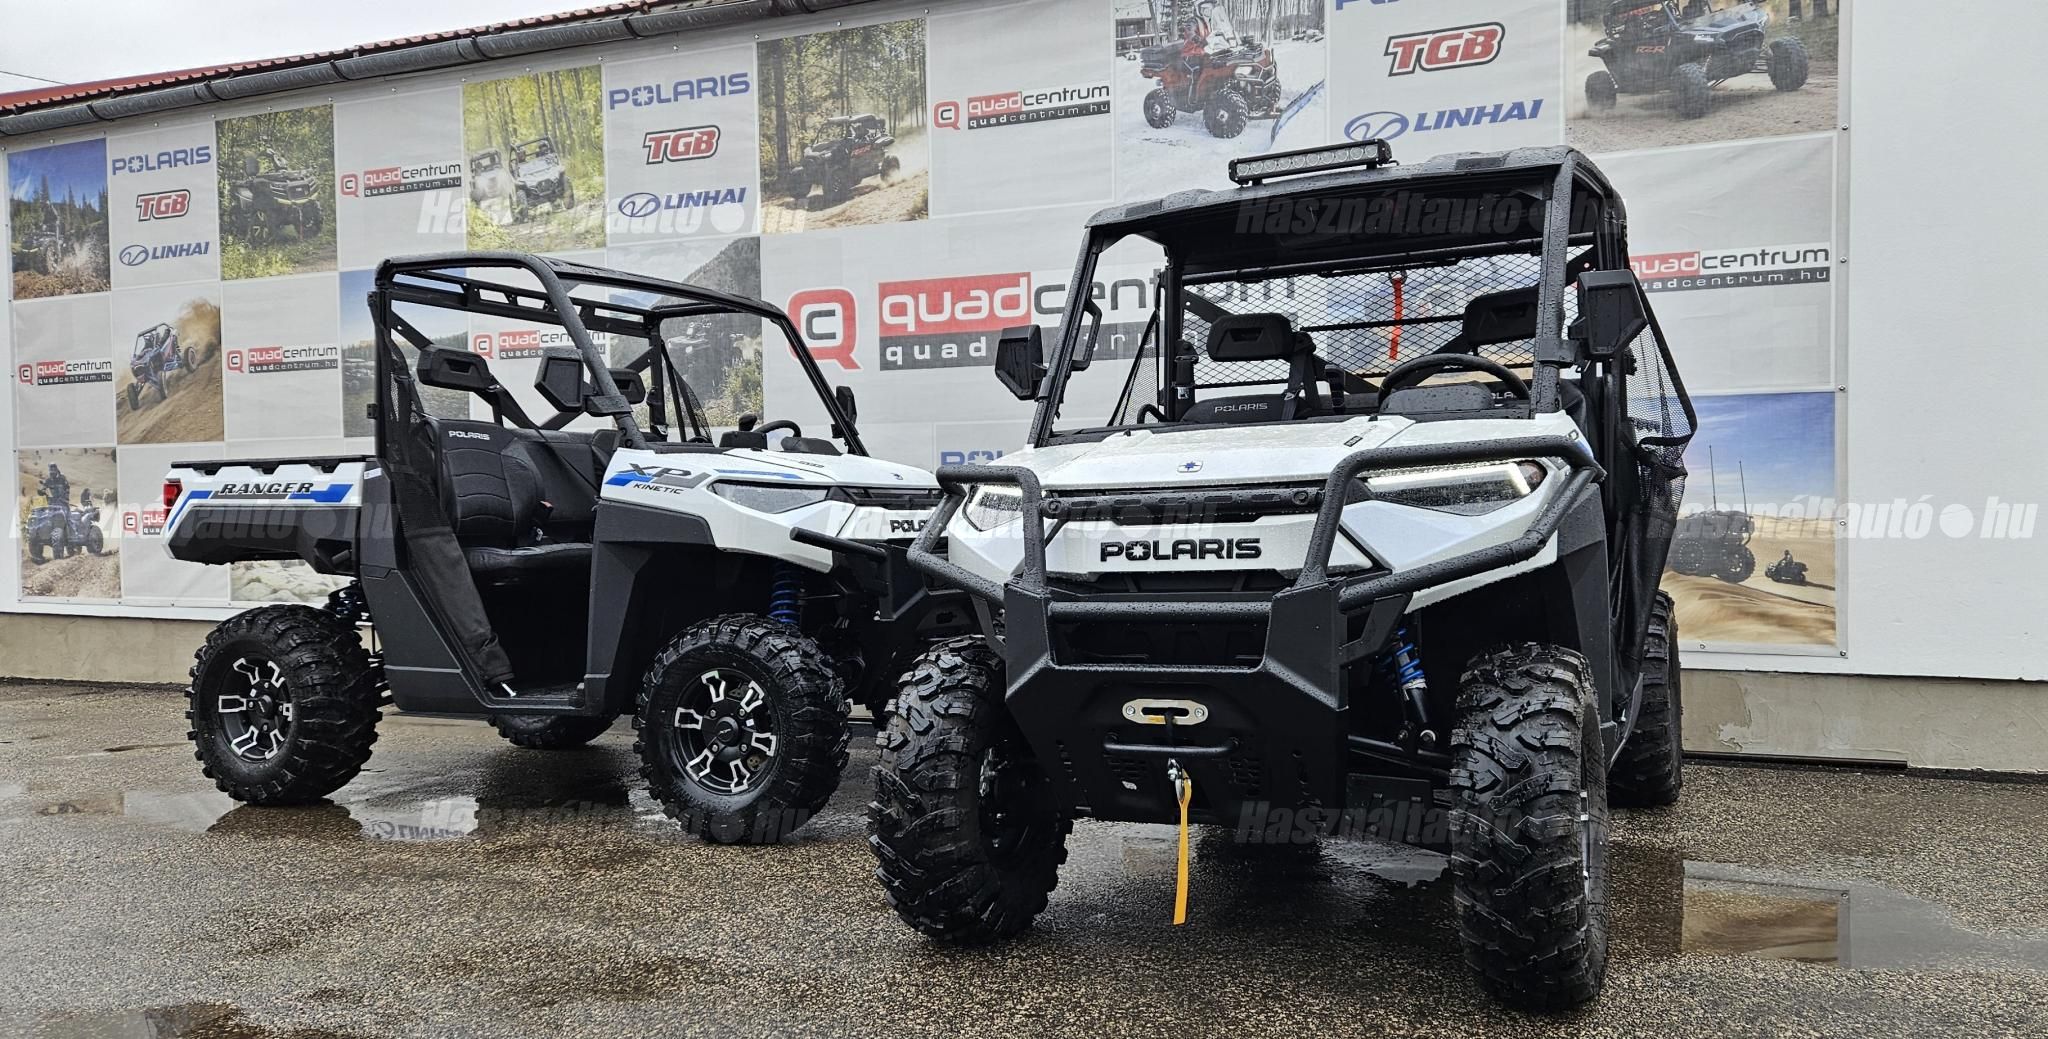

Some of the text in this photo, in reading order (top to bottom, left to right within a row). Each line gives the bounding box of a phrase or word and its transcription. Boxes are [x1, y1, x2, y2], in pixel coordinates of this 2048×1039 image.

[1386, 24, 1503, 75] TGB
[609, 72, 751, 110] POLARIS
[969, 85, 1110, 115] quadcentrum
[970, 103, 1109, 127] quadcentrum.hu
[1413, 99, 1544, 132] LINHAI
[644, 127, 719, 163] TGB
[112, 146, 211, 175] POLARIS
[365, 164, 461, 185] quadcentrum
[138, 190, 191, 220] TGB
[664, 187, 746, 211] LINHAI
[151, 241, 210, 261] LINHAI
[249, 347, 337, 363] quadcentrum
[37, 361, 112, 376] quadcentrum
[1214, 403, 1268, 413] POLARIS
[448, 431, 490, 440] POLARIS
[617, 463, 692, 477] XP
[219, 482, 314, 495] RANGER
[633, 483, 684, 495] KINETIC
[1100, 538, 1262, 562] POLARIS
